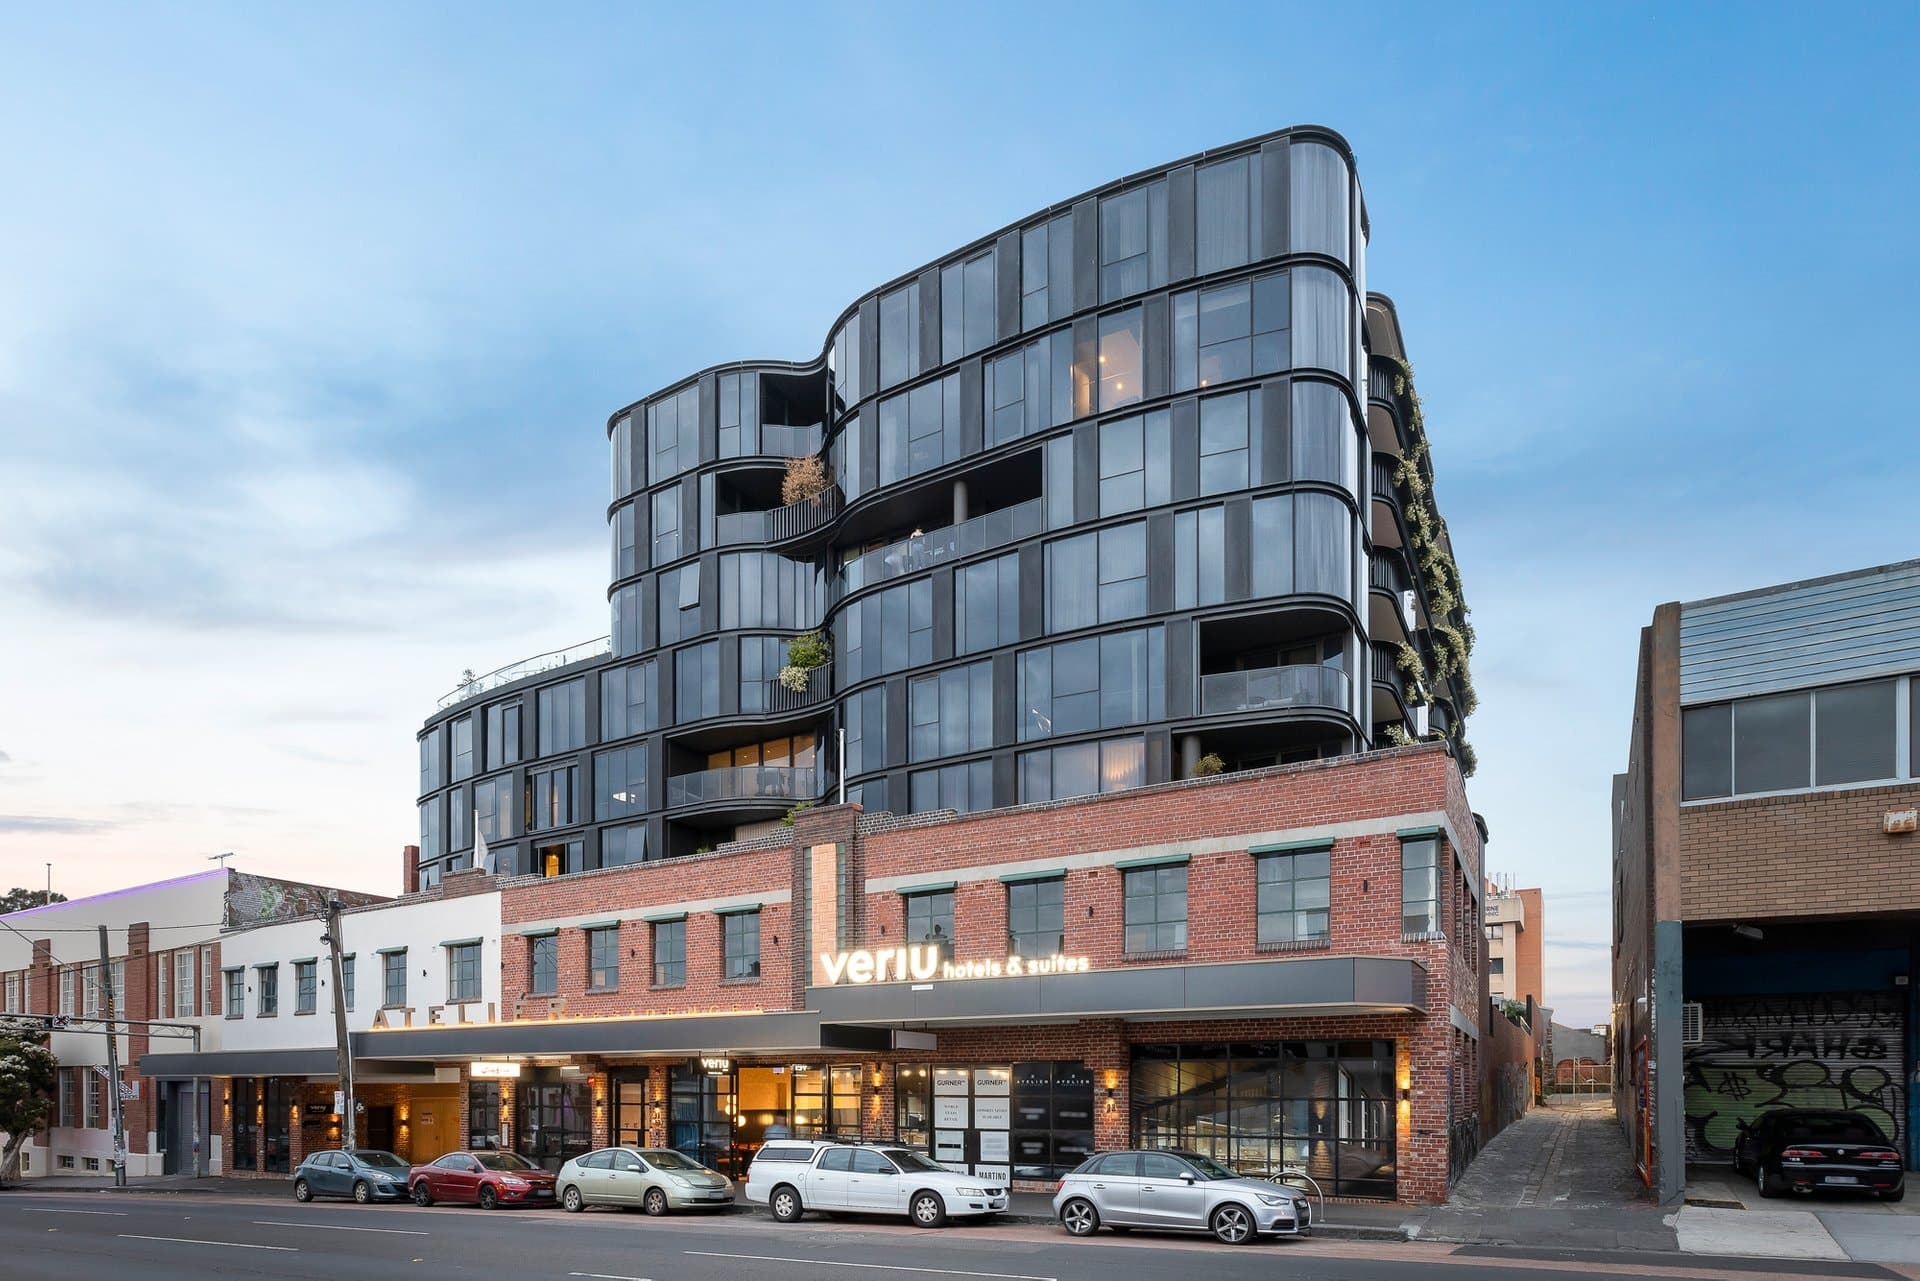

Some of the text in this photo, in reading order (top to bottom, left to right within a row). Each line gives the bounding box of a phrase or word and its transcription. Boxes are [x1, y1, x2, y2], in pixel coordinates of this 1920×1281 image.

[821, 945, 1089, 984] veriu hotels & suites
[979, 1170, 1007, 1181] MARTINO
